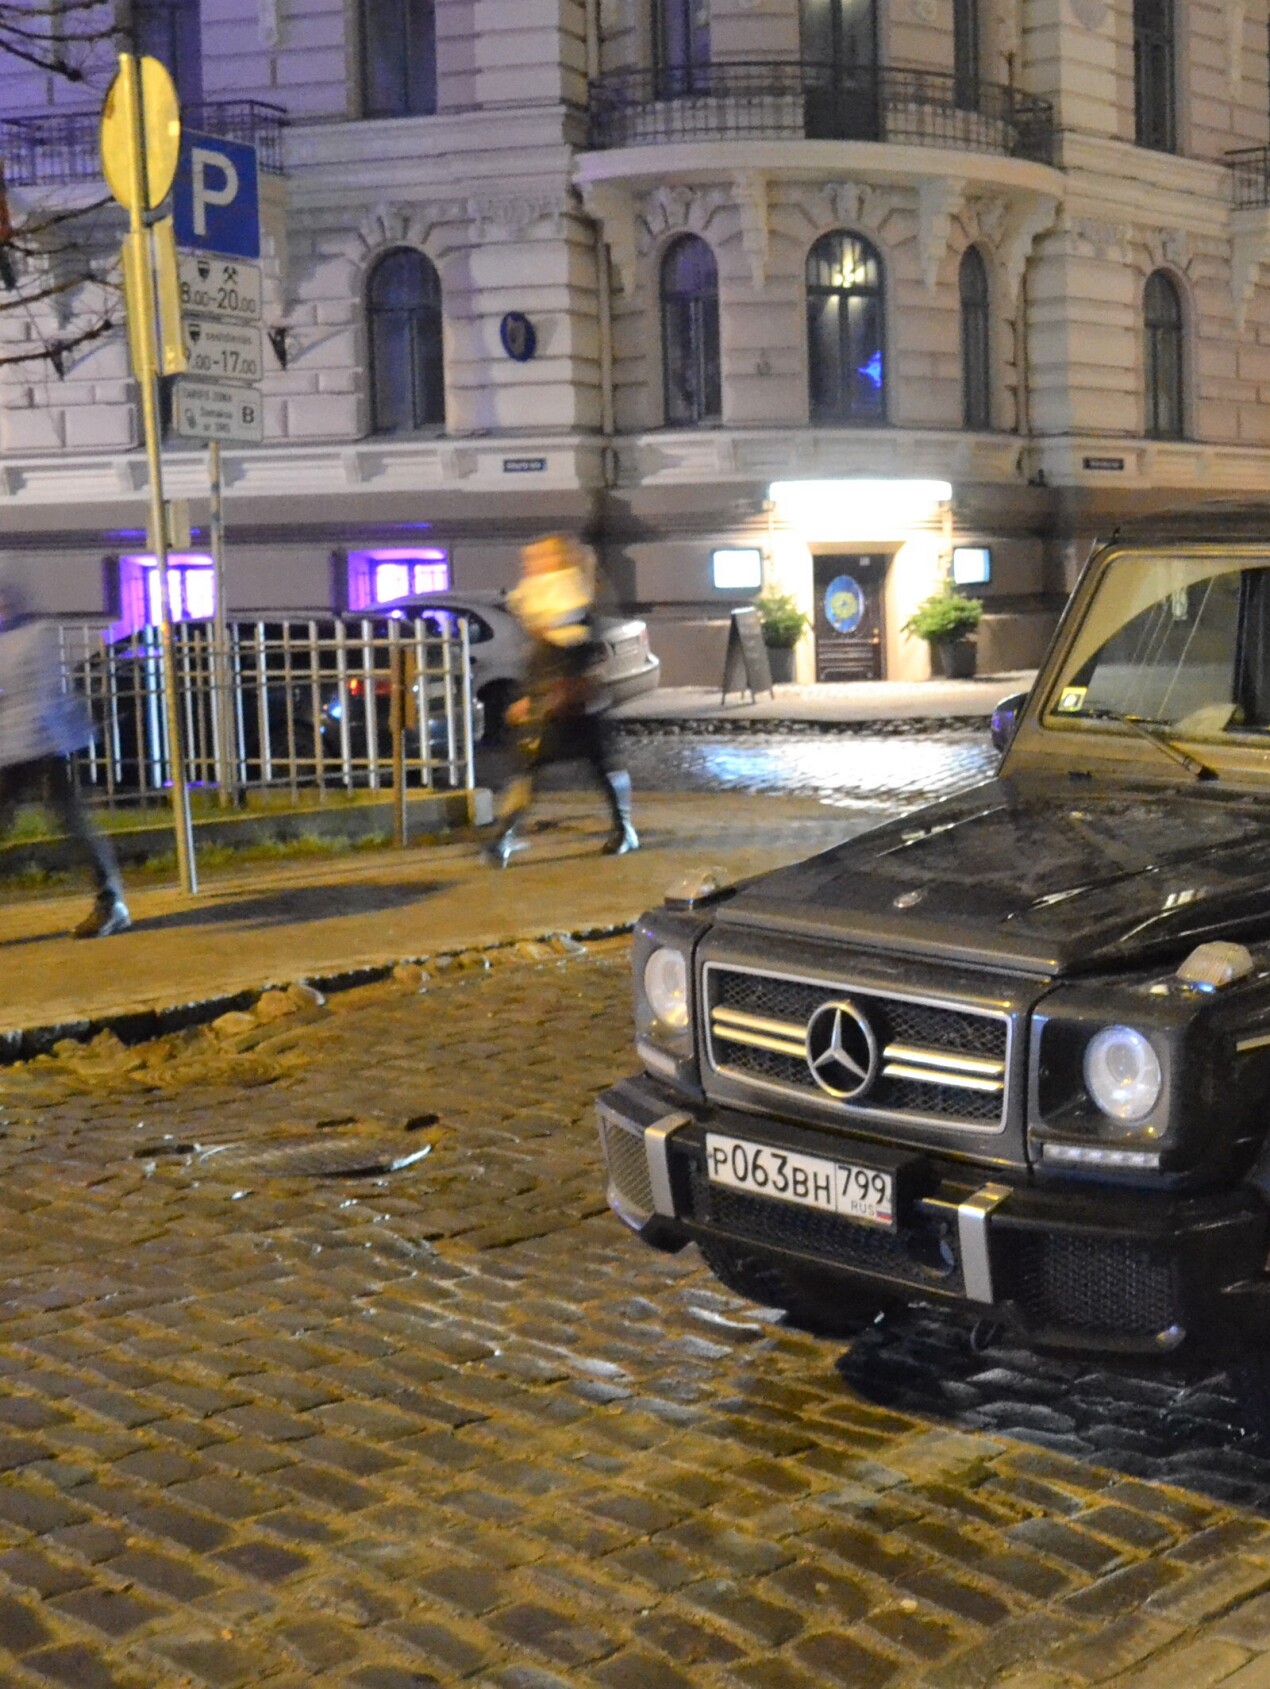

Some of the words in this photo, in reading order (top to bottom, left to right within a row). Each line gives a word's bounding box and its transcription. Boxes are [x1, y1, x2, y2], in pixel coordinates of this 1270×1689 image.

[191, 146, 239, 236] P
[242, 405, 255, 424] B
[713, 1144, 831, 1205] P063BH
[838, 1164, 886, 1205] 799
[851, 1200, 875, 1217] RUS
